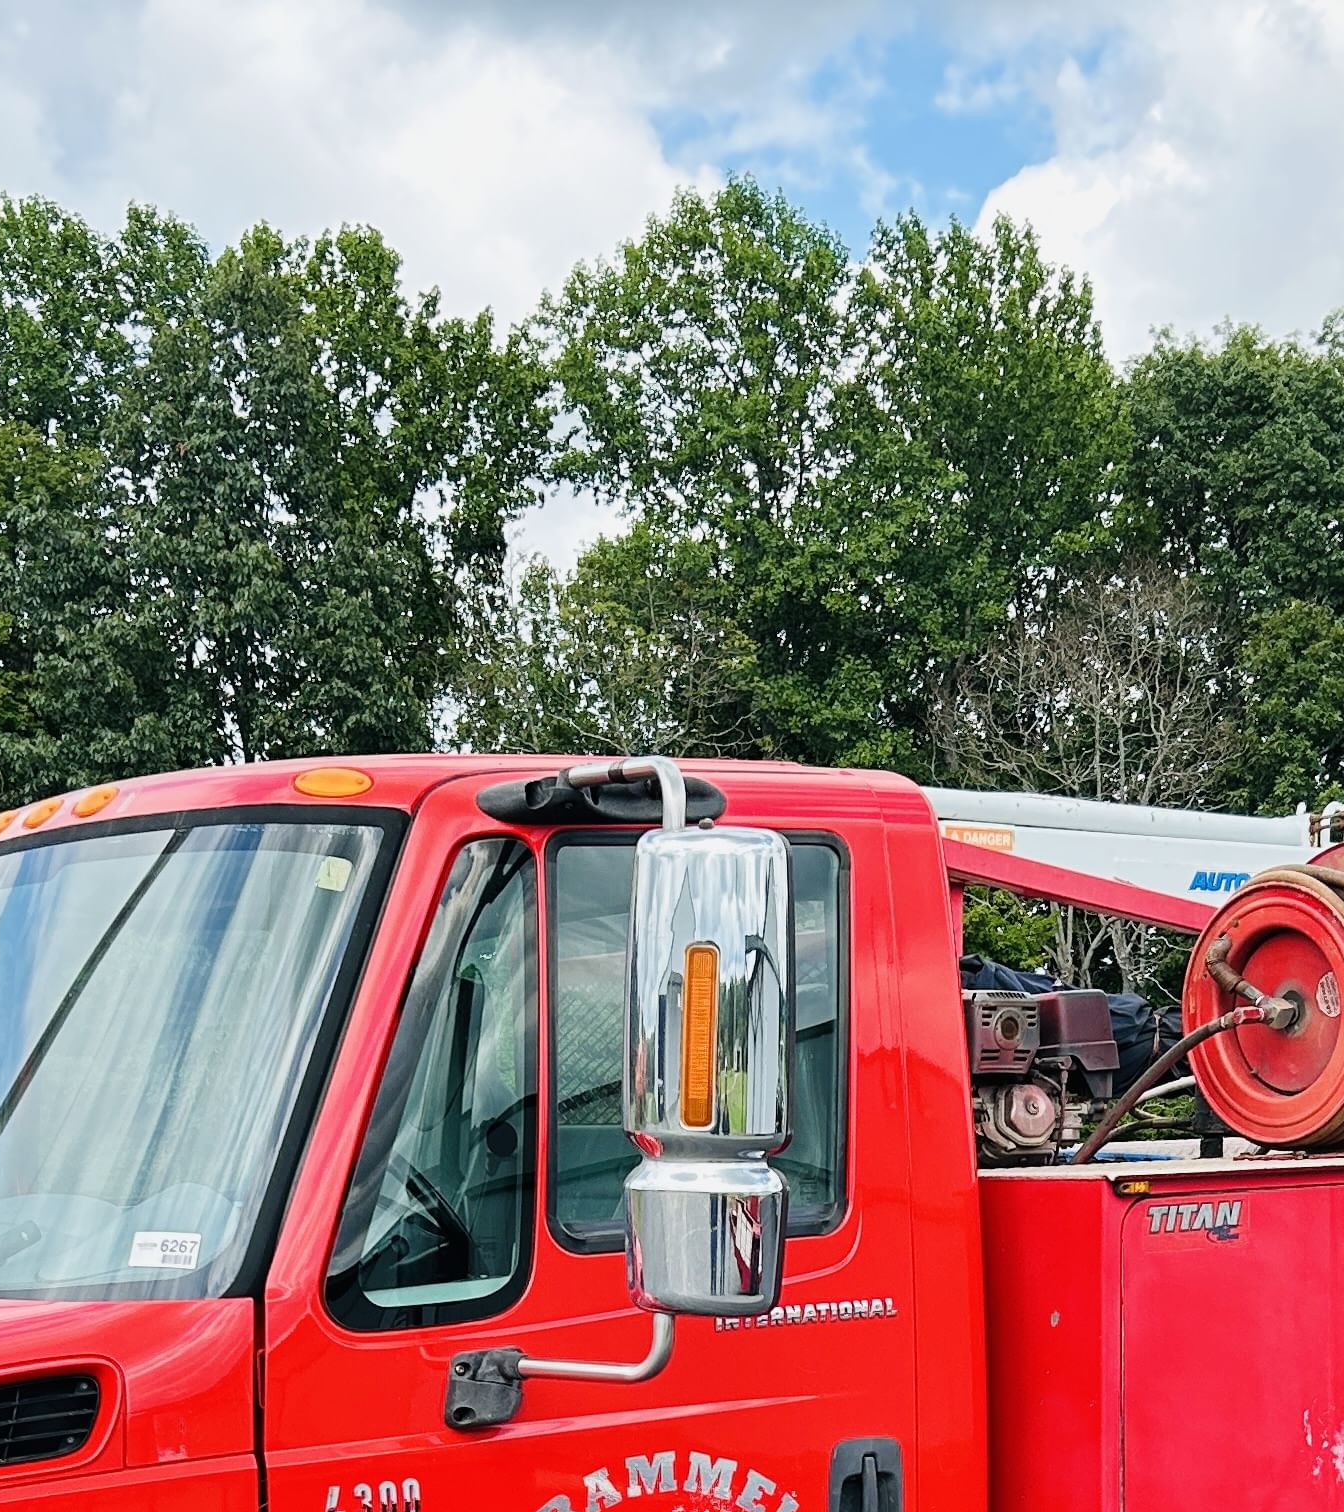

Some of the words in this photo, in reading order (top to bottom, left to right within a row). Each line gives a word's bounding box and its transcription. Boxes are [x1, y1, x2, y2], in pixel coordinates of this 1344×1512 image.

[963, 832, 1011, 847] DANGER
[1148, 1201, 1242, 1233] TITAN
[160, 1239, 198, 1254] 6267
